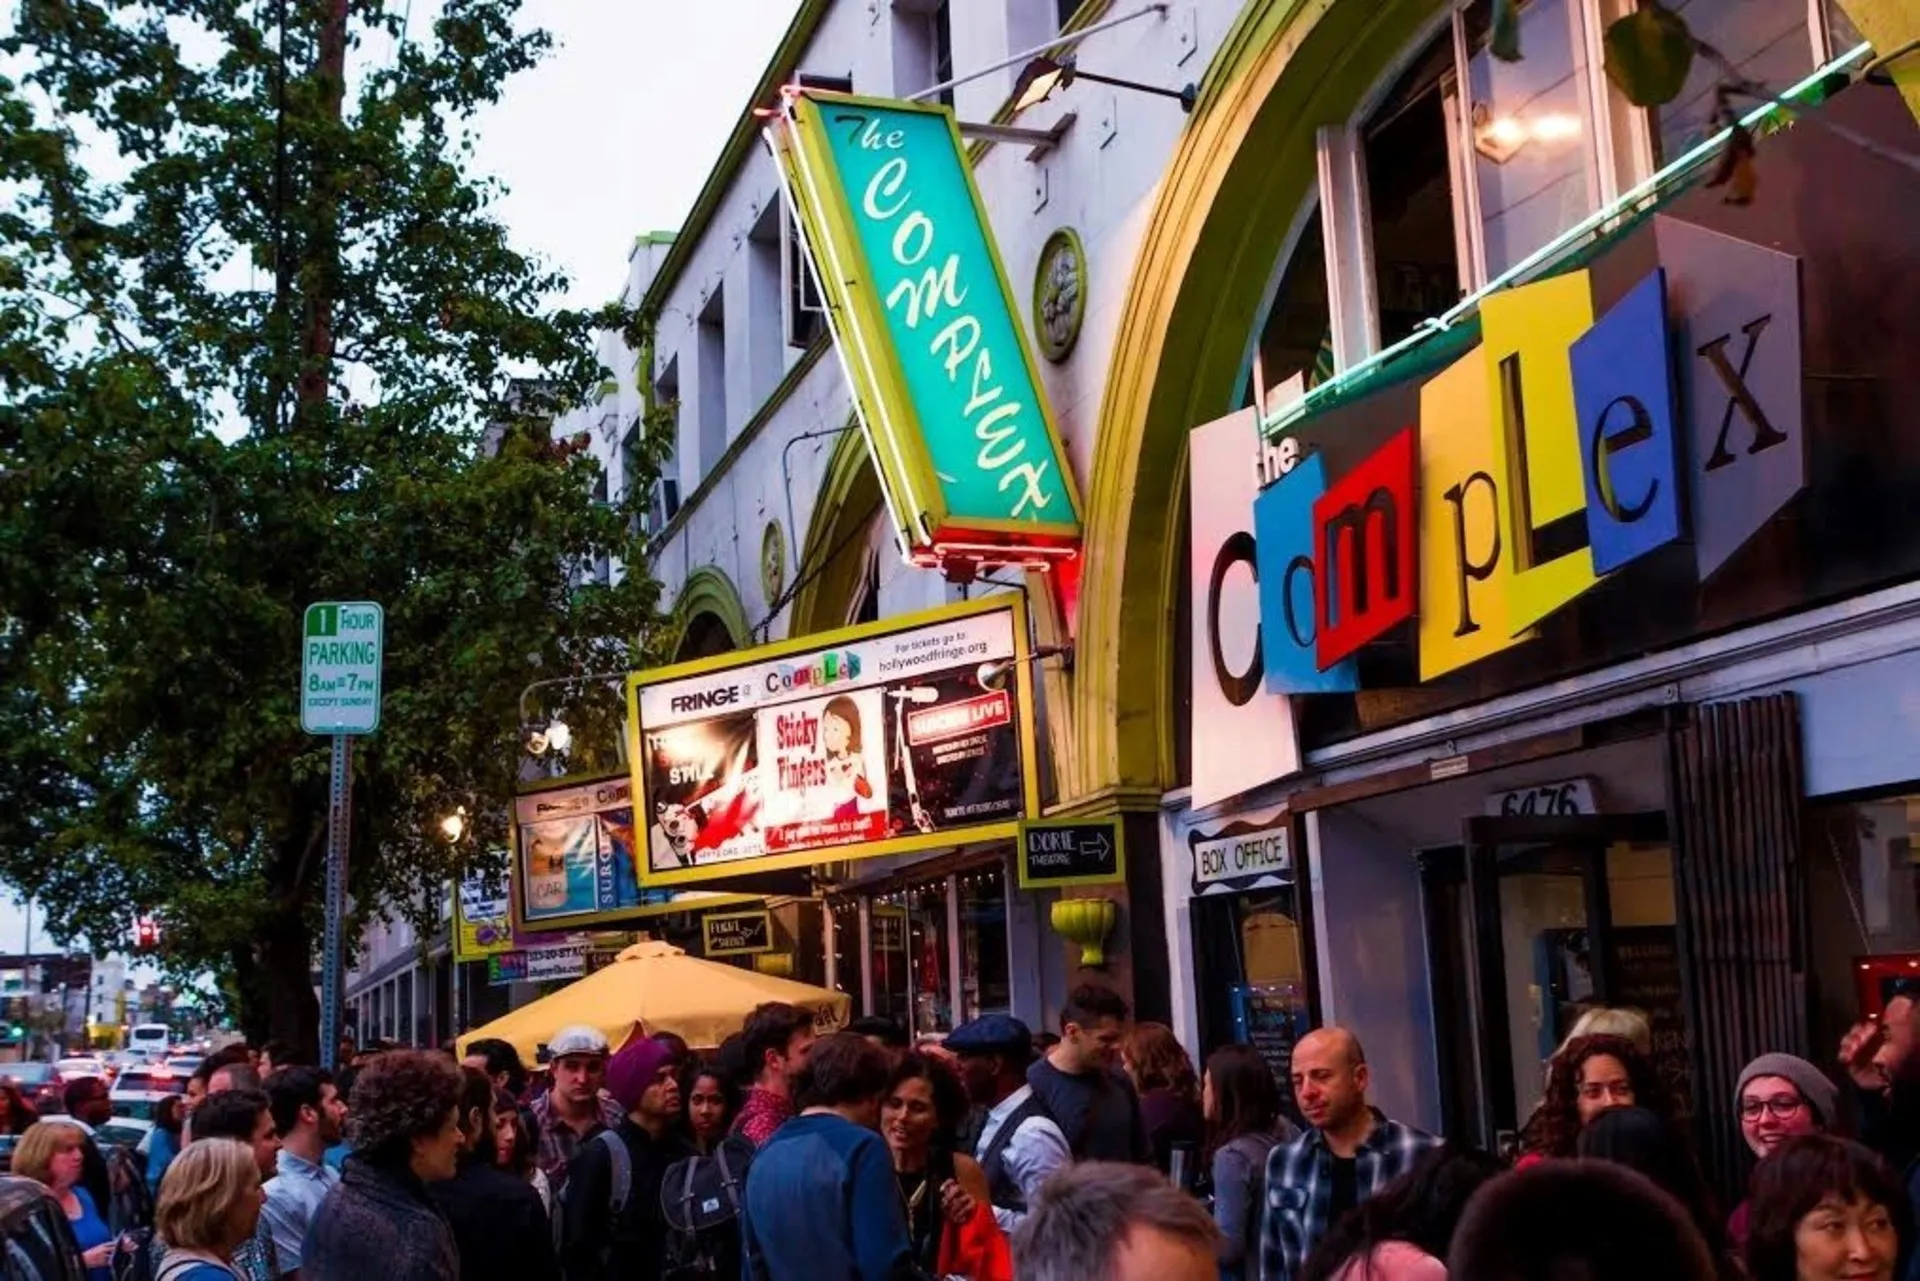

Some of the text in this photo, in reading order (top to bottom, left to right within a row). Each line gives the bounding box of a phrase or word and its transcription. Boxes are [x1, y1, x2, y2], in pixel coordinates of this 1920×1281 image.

[834, 115, 905, 149] The
[341, 609, 375, 630] HOUR
[308, 642, 376, 666] PARKING
[879, 642, 988, 672] hollywoodfringe.org
[911, 637, 940, 651] tickets
[341, 697, 373, 706] SUNDAY
[671, 685, 740, 713] FRINGE
[971, 699, 1005, 722] LIVE
[777, 711, 819, 754] Sticky
[777, 756, 827, 797] Fingers
[1502, 783, 1580, 816] 6476
[1029, 830, 1077, 852] DORIE
[1202, 836, 1282, 876] BOX OFFICE
